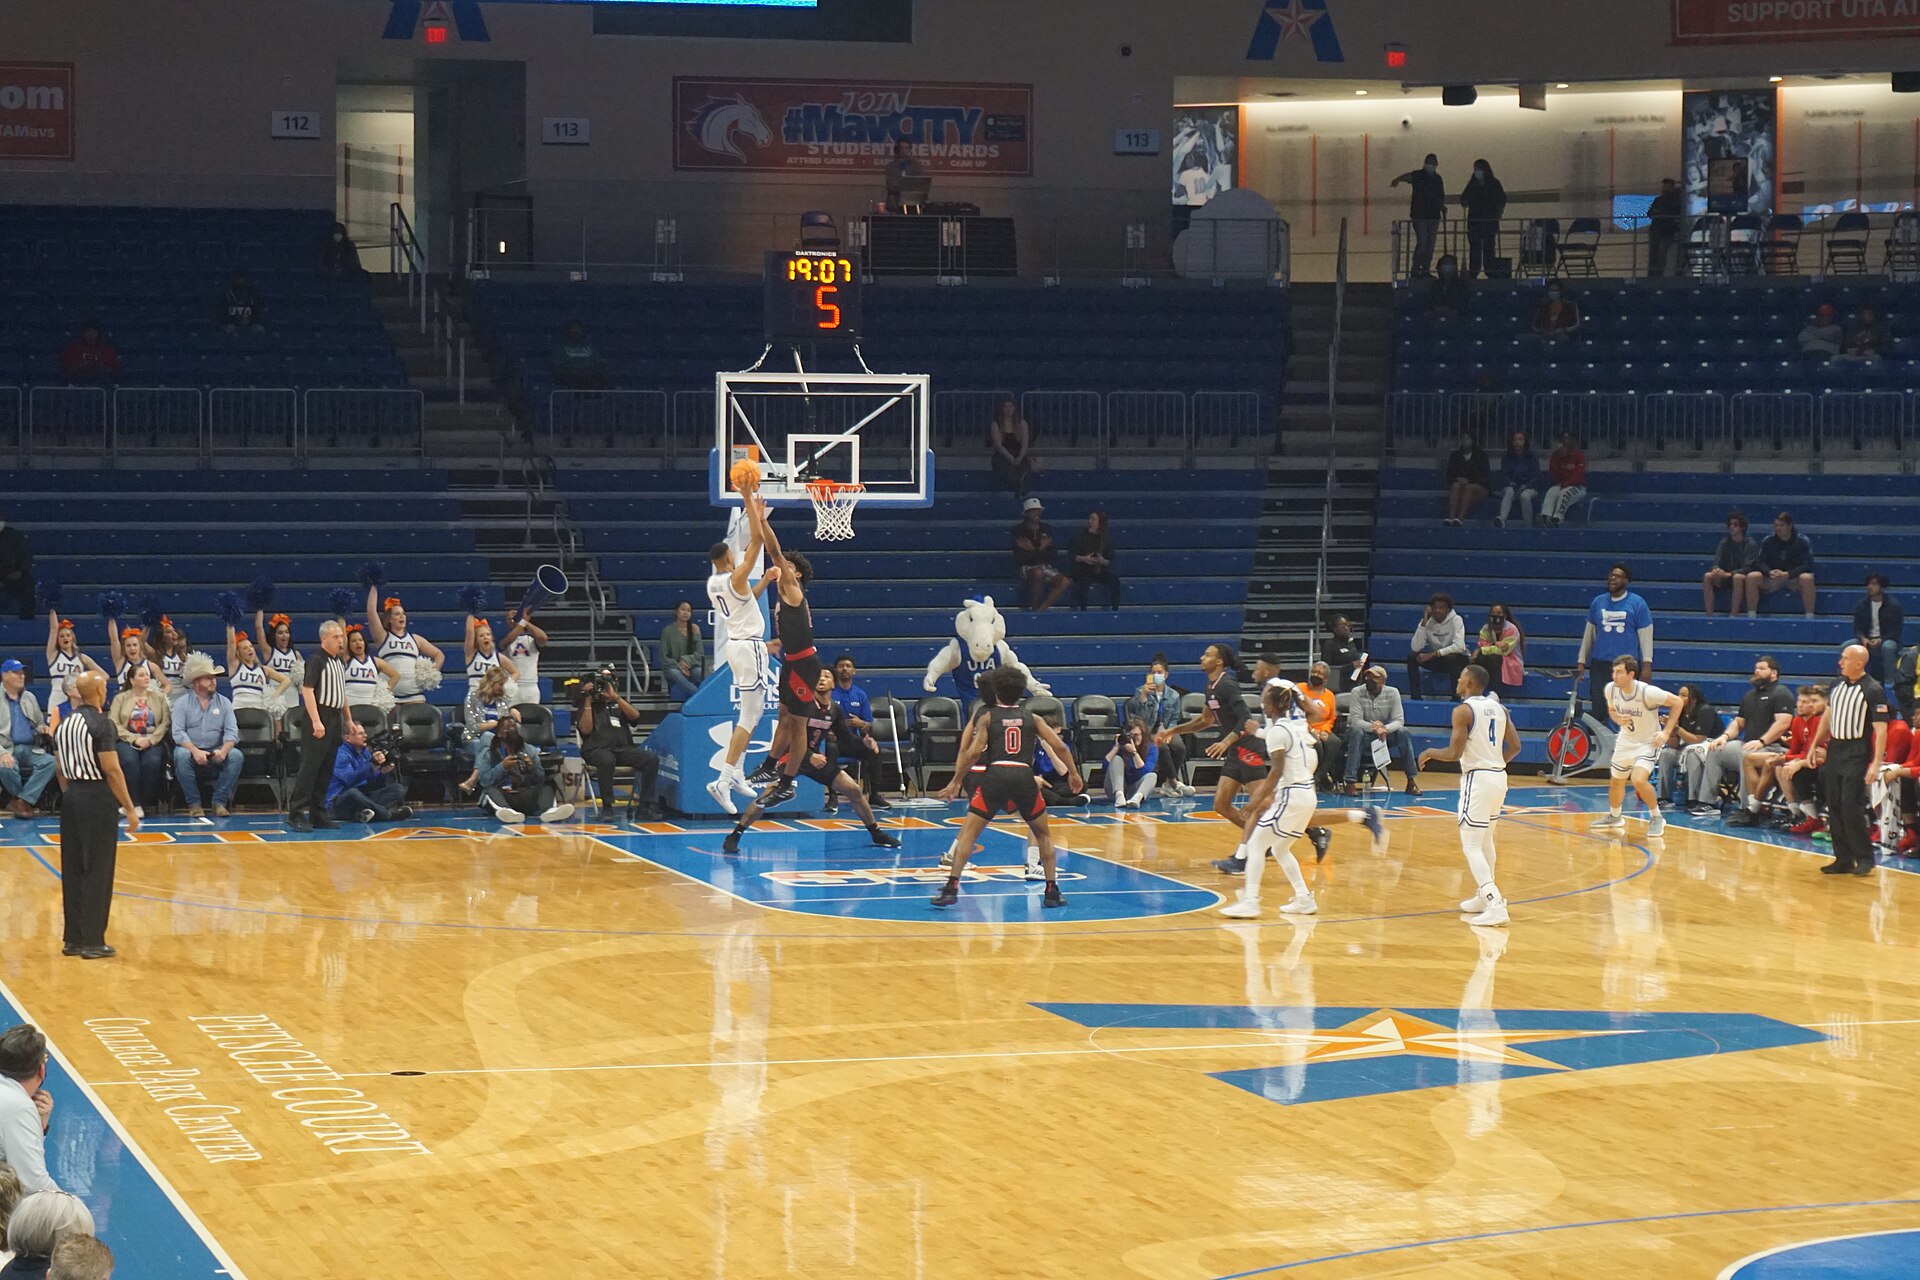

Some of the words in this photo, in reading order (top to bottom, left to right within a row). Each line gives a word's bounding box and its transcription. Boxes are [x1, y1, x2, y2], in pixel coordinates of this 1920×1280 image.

[1727, 0, 1833, 23] SUPPORT
[1842, 0, 1887, 18] UTA
[427, 28, 446, 42] EXIT
[841, 83, 912, 113] JOIN
[283, 116, 309, 130] 112
[553, 122, 579, 137] 113
[1125, 132, 1149, 147] 113
[808, 143, 895, 156] STUDENT
[786, 157, 821, 165] ATTEND
[787, 257, 852, 283] 19:07
[229, 306, 252, 316] UTA
[815, 284, 841, 328] 5
[716, 595, 730, 617] 0
[389, 640, 414, 650] UTA
[56, 663, 81, 673] UTA
[350, 667, 375, 678] UTA
[239, 672, 264, 685] UTA
[1005, 727, 1021, 754] 0
[1488, 718, 1496, 746] 4
[83, 1017, 173, 1067] COLLEGE
[130, 1067, 208, 1102] PARK
[187, 1013, 344, 1084] PETSCHE
[271, 1087, 433, 1156] COURT
[163, 1104, 263, 1164] CENTER
